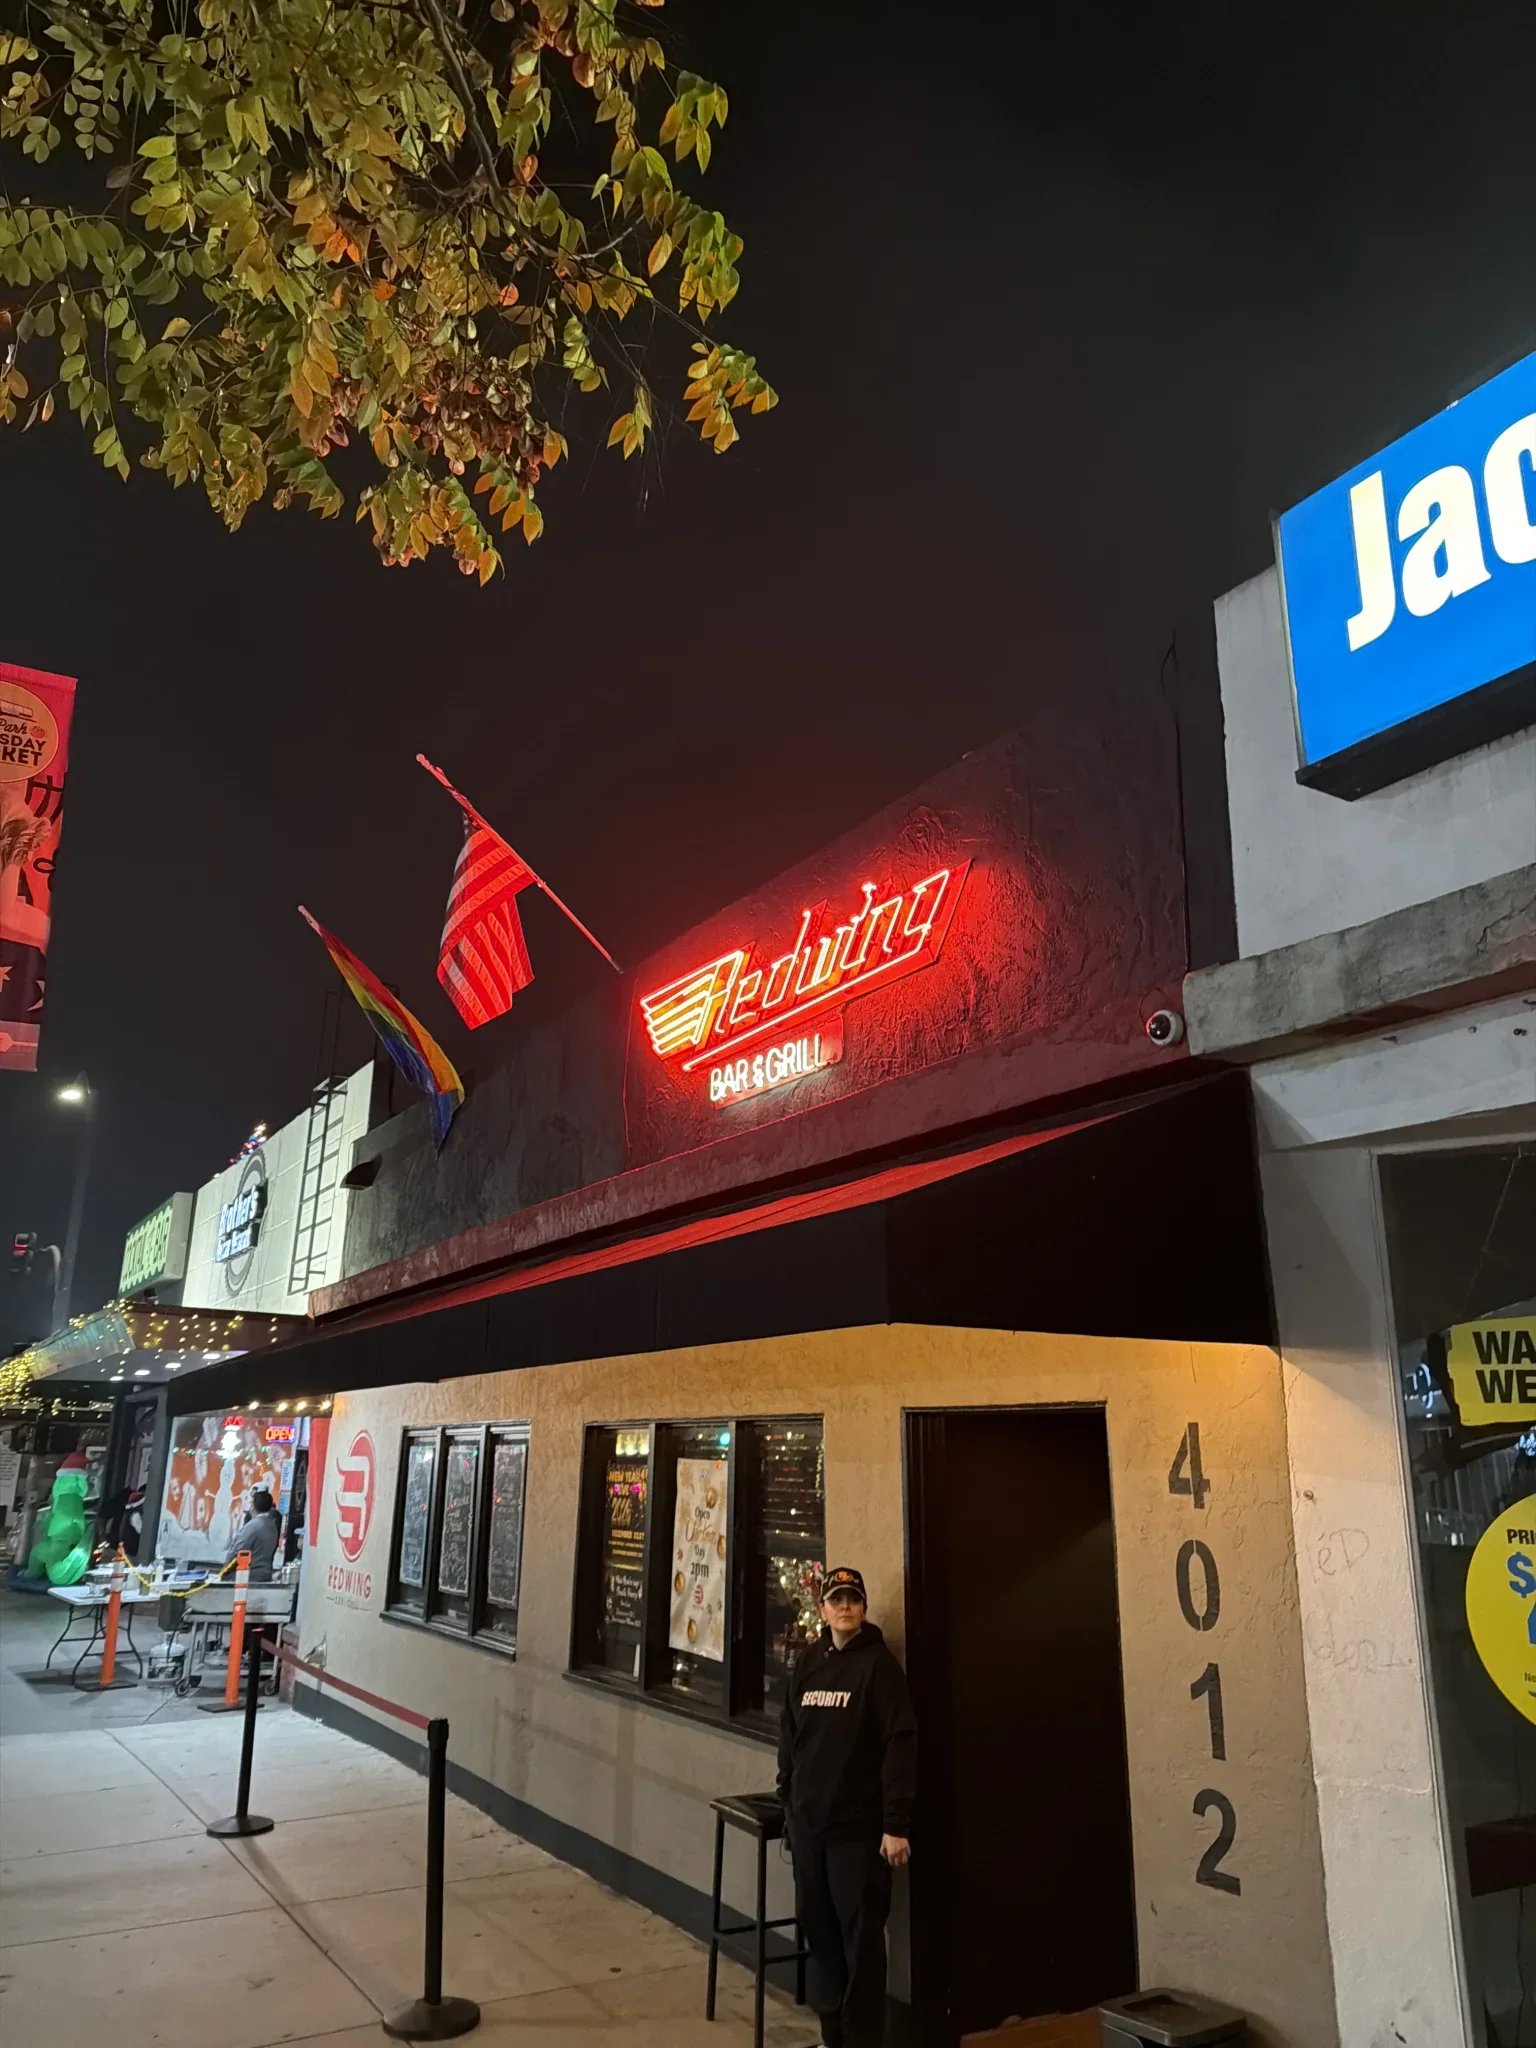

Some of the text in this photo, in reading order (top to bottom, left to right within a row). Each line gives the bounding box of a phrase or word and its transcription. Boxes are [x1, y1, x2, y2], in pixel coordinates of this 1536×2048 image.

[2, 746, 42, 767] KET
[710, 1058, 748, 1102] BAR
[765, 1033, 828, 1083] GRILL
[1472, 1331, 1536, 1364] WA
[1475, 1370, 1536, 1403] WE
[266, 1427, 294, 1441] OPEN
[327, 1564, 372, 1599] REDWING
[690, 1562, 709, 1581] 2pm
[801, 1690, 851, 1708] SECURITY
